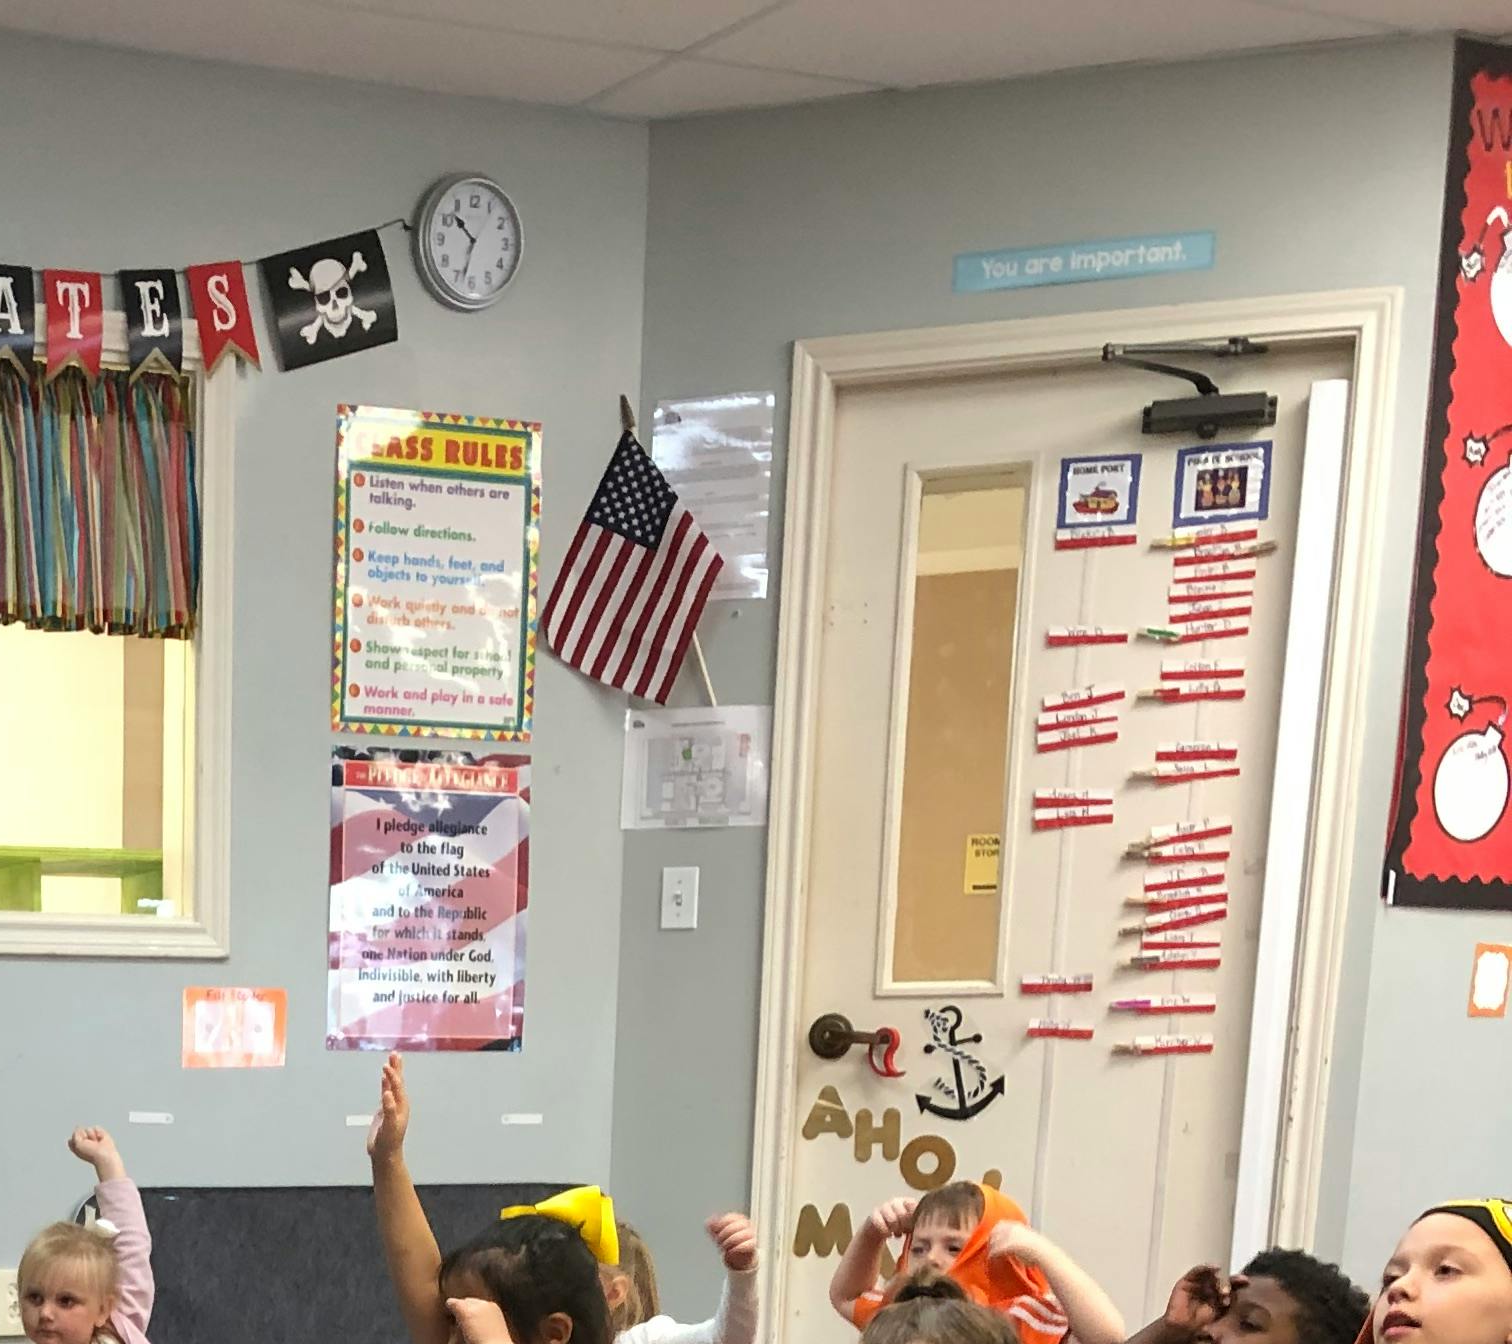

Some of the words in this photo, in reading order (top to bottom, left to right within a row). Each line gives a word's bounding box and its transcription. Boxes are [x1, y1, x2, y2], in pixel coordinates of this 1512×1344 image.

[982, 259, 1018, 278] You
[1025, 256, 1063, 273] are
[1070, 240, 1186, 271] important.
[445, 439, 523, 470] RULES
[370, 475, 404, 490] Listen
[408, 481, 443, 494] when
[447, 484, 485, 499] others
[490, 489, 510, 500] are
[370, 493, 416, 510] talking.
[414, 525, 476, 542] directions.
[364, 685, 398, 699] Work
[403, 688, 428, 700] and
[431, 690, 458, 705] play
[462, 692, 473, 702] in
[478, 695, 484, 704] a
[489, 694, 513, 706] safe
[364, 704, 414, 717] manner.
[384, 819, 424, 836] pledge
[428, 821, 487, 836] allegiance
[401, 842, 413, 854] to
[417, 842, 436, 854] the
[440, 842, 464, 859] flag
[412, 863, 450, 875] United
[454, 864, 490, 878] States
[427, 970, 453, 982] with
[457, 970, 496, 987] liberty
[802, 1085, 1002, 1191] AHO
